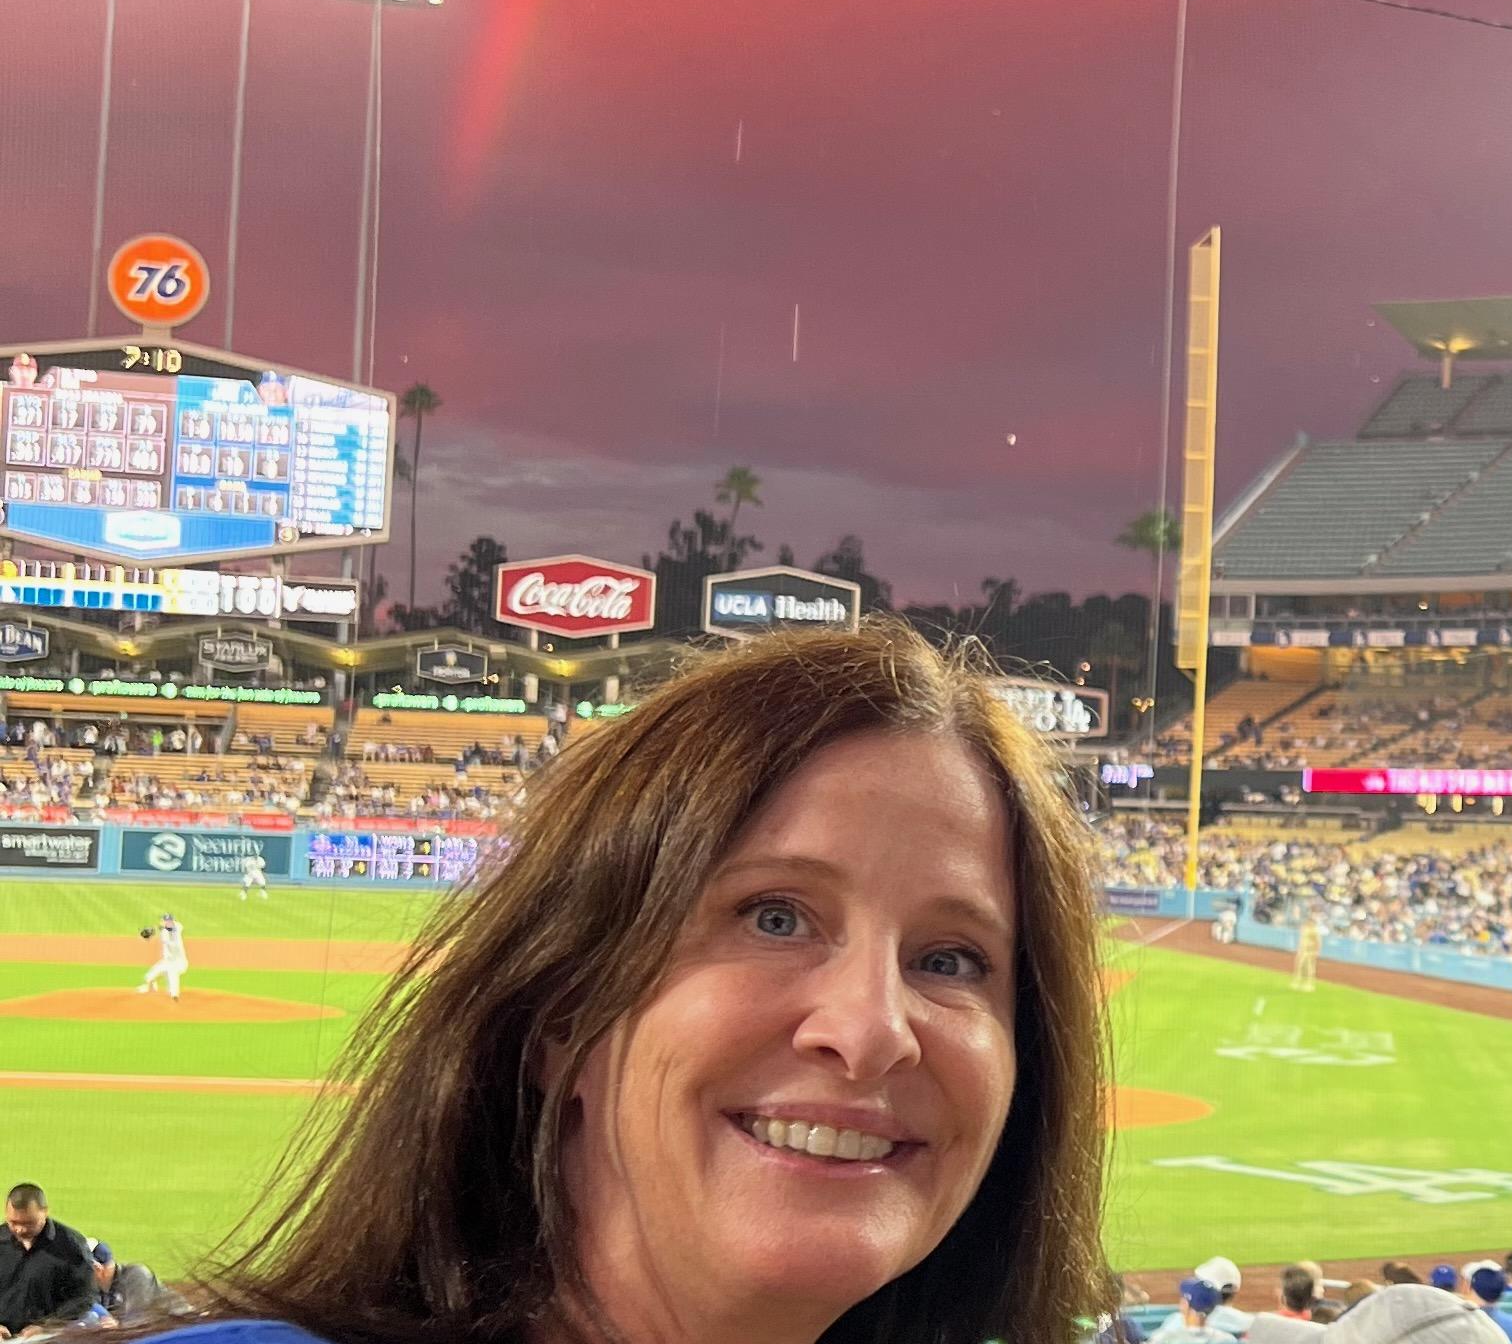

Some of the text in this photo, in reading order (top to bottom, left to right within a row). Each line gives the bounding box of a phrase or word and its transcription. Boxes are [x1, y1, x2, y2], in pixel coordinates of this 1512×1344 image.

[134, 264, 188, 298] 76
[121, 346, 182, 373] 7:10
[714, 592, 846, 621] UCLA Health
[2, 833, 92, 850] smartwater
[192, 835, 264, 856] Security
